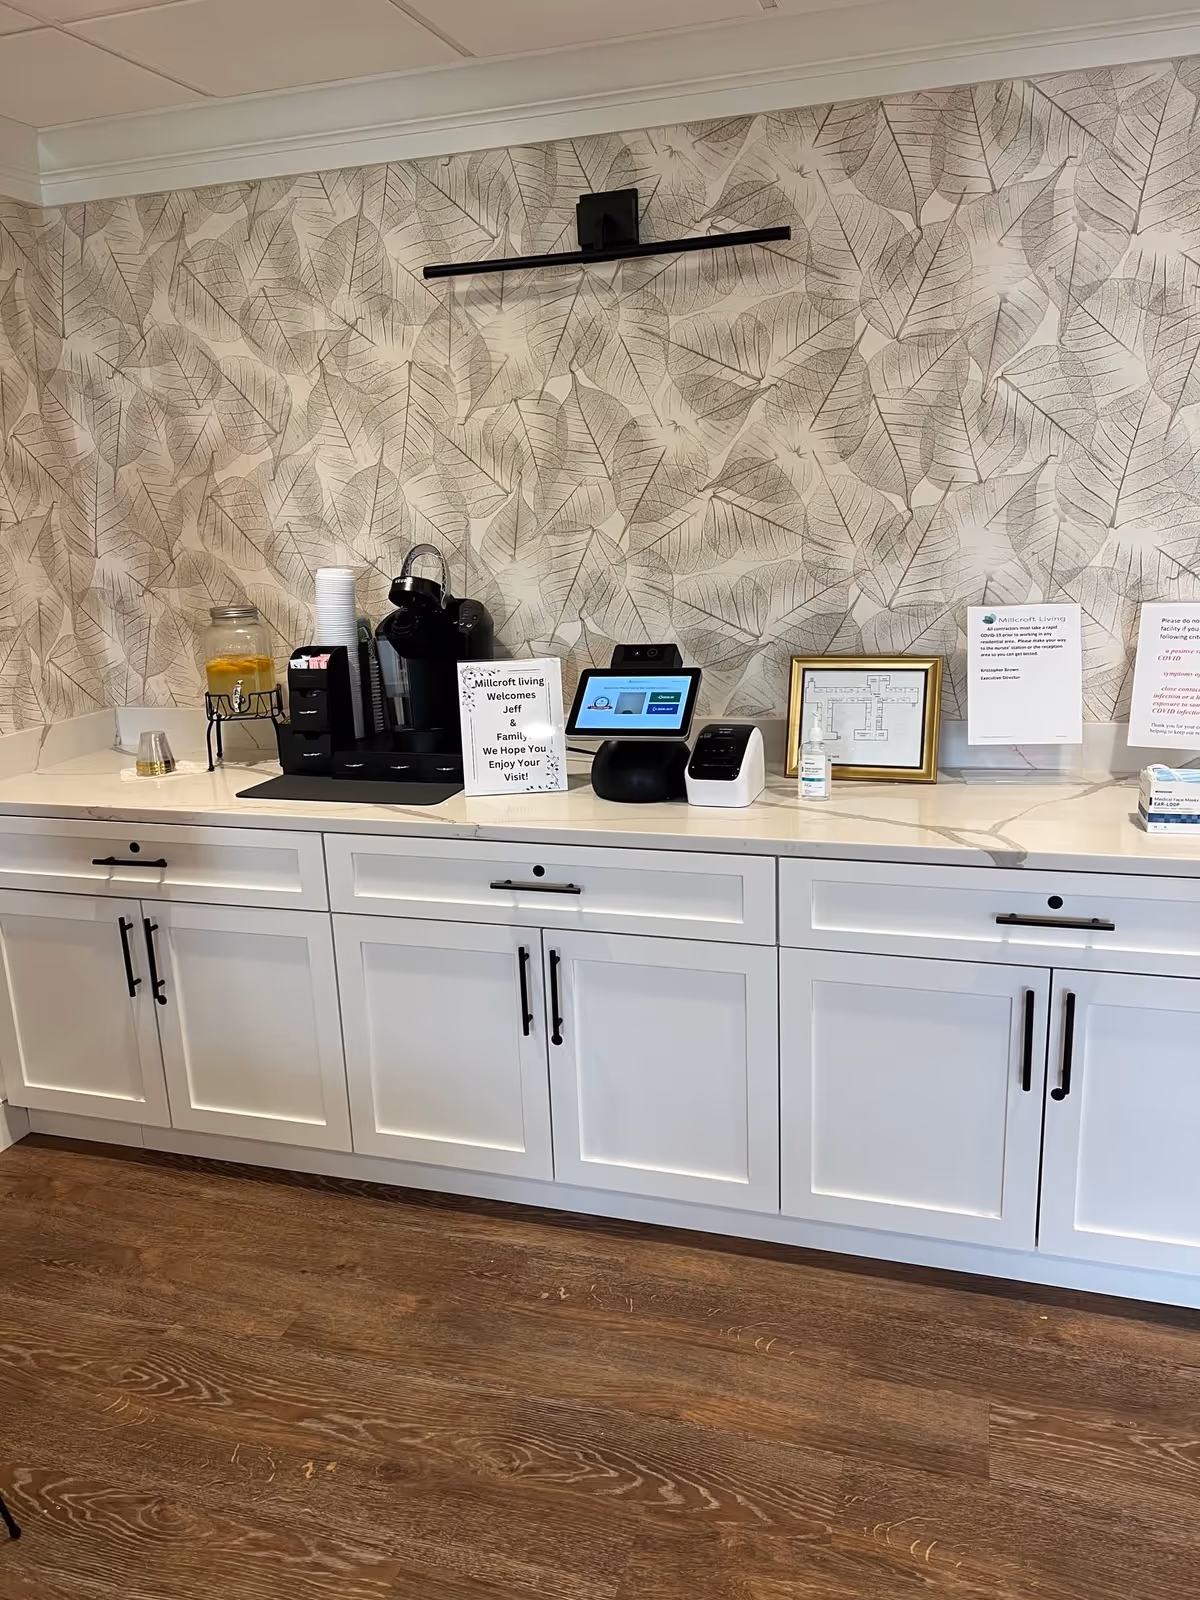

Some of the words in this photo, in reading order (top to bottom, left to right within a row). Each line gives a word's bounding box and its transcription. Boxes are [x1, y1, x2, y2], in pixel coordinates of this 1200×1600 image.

[475, 678, 516, 688] Millcroft
[518, 677, 545, 687] living
[487, 692, 536, 700] Welcomes
[503, 704, 522, 714] Jeff
[509, 718, 517, 727] &
[500, 746, 525, 755] Hope
[489, 760, 515, 770] Enjoy
[504, 773, 528, 781] Visit!
